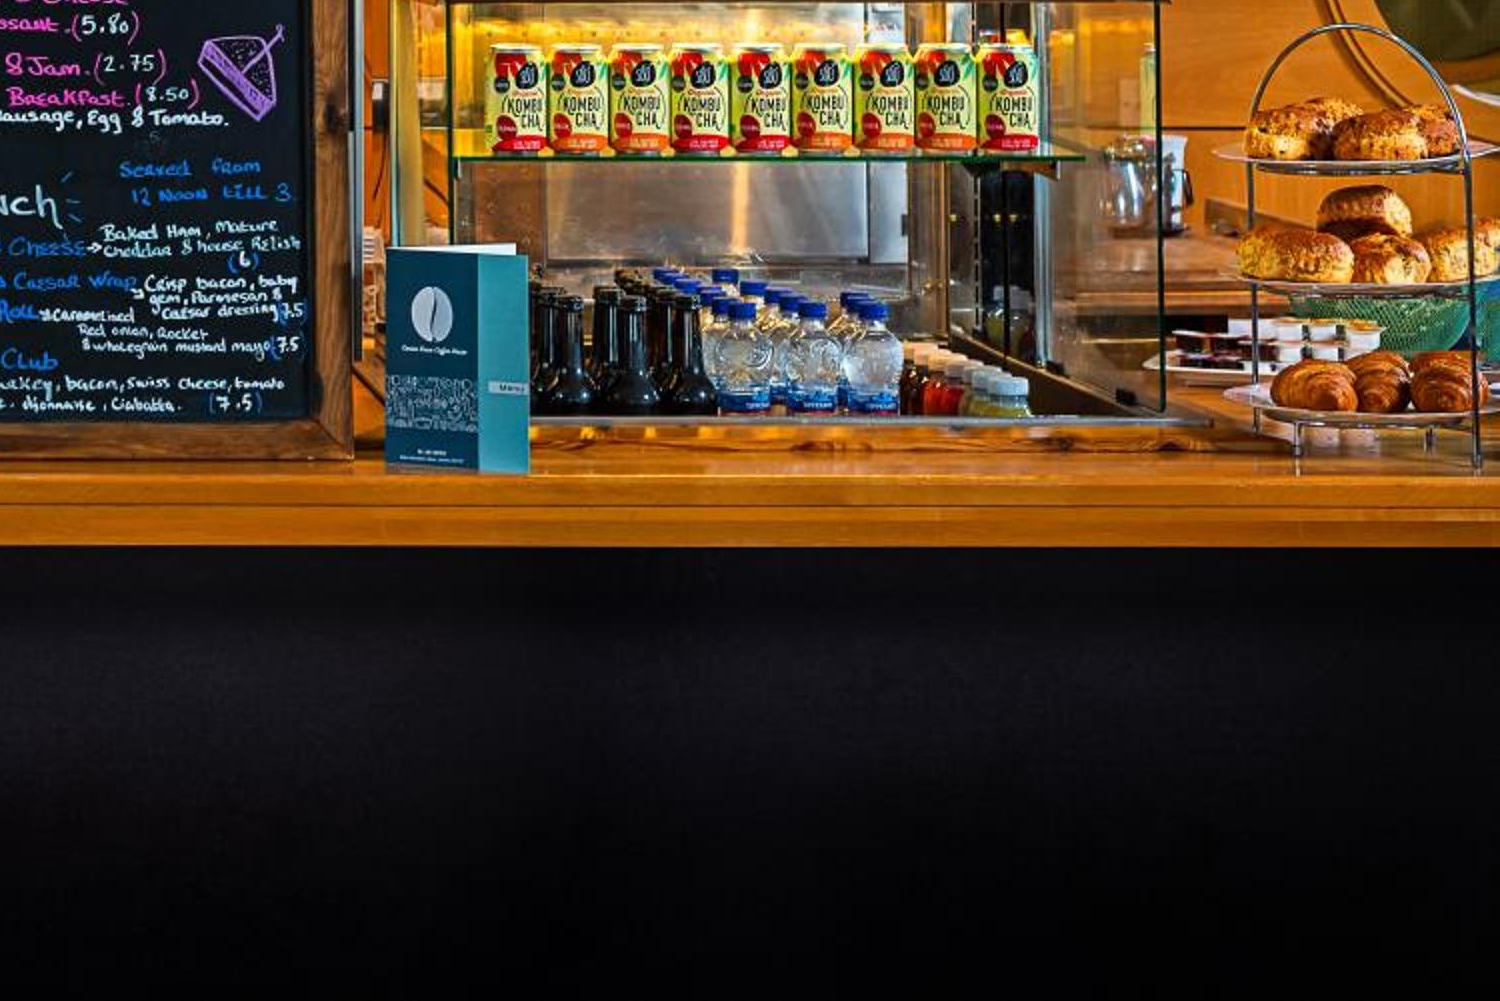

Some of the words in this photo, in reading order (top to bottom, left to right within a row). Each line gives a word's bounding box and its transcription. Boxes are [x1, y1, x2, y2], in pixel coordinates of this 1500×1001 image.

[87, 109, 122, 134] Egg
[521, 114, 544, 131] CHA
[576, 113, 601, 130] CHA
[635, 112, 660, 129] CHA
[696, 113, 720, 131] CHA
[764, 112, 787, 130] CHA
[820, 111, 845, 129] CHA
[886, 112, 909, 129] CHA
[940, 112, 966, 130] CHA
[1009, 112, 1033, 130] CHA
[131, 187, 152, 206] 12
[276, 183, 292, 202] 3
[100, 223, 158, 242] Baked
[258, 274, 299, 295] baby
[191, 290, 268, 304] Parmesan
[217, 303, 279, 323] dressing
[77, 322, 106, 337] Red
